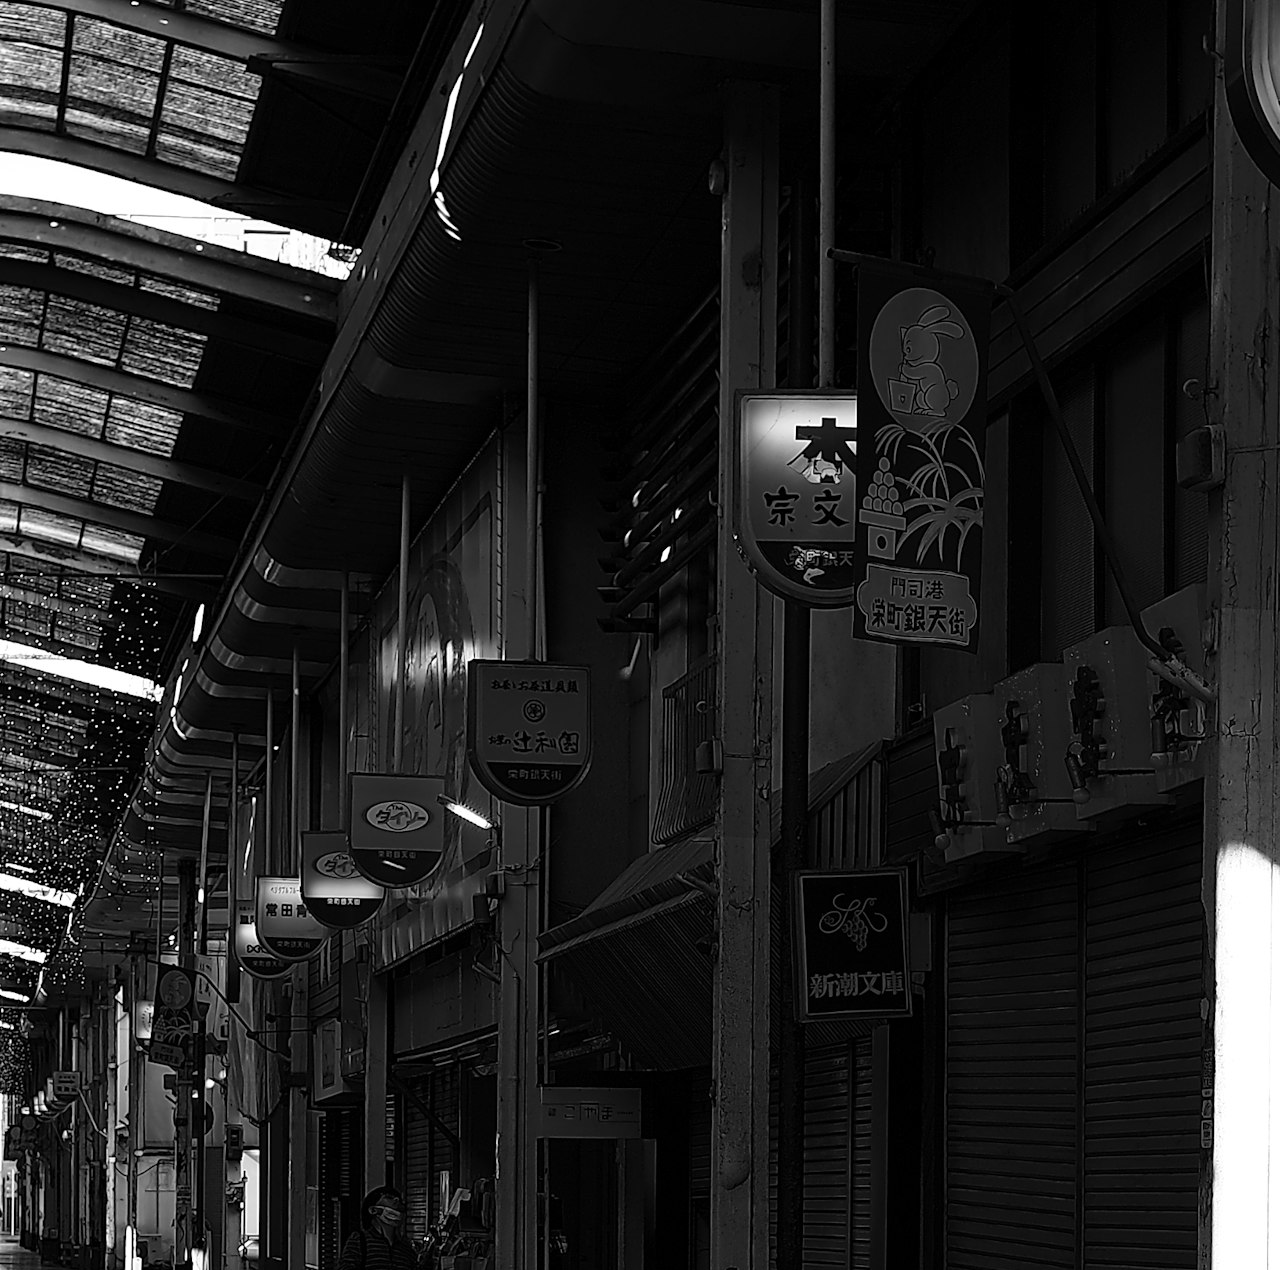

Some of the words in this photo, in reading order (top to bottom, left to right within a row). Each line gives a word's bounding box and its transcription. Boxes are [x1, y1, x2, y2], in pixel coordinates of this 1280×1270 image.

[764, 486, 850, 527] 宗文
[891, 577, 944, 600] 門司港
[871, 599, 965, 636] 栄町銀天街
[809, 970, 904, 998] 新潮文庫
